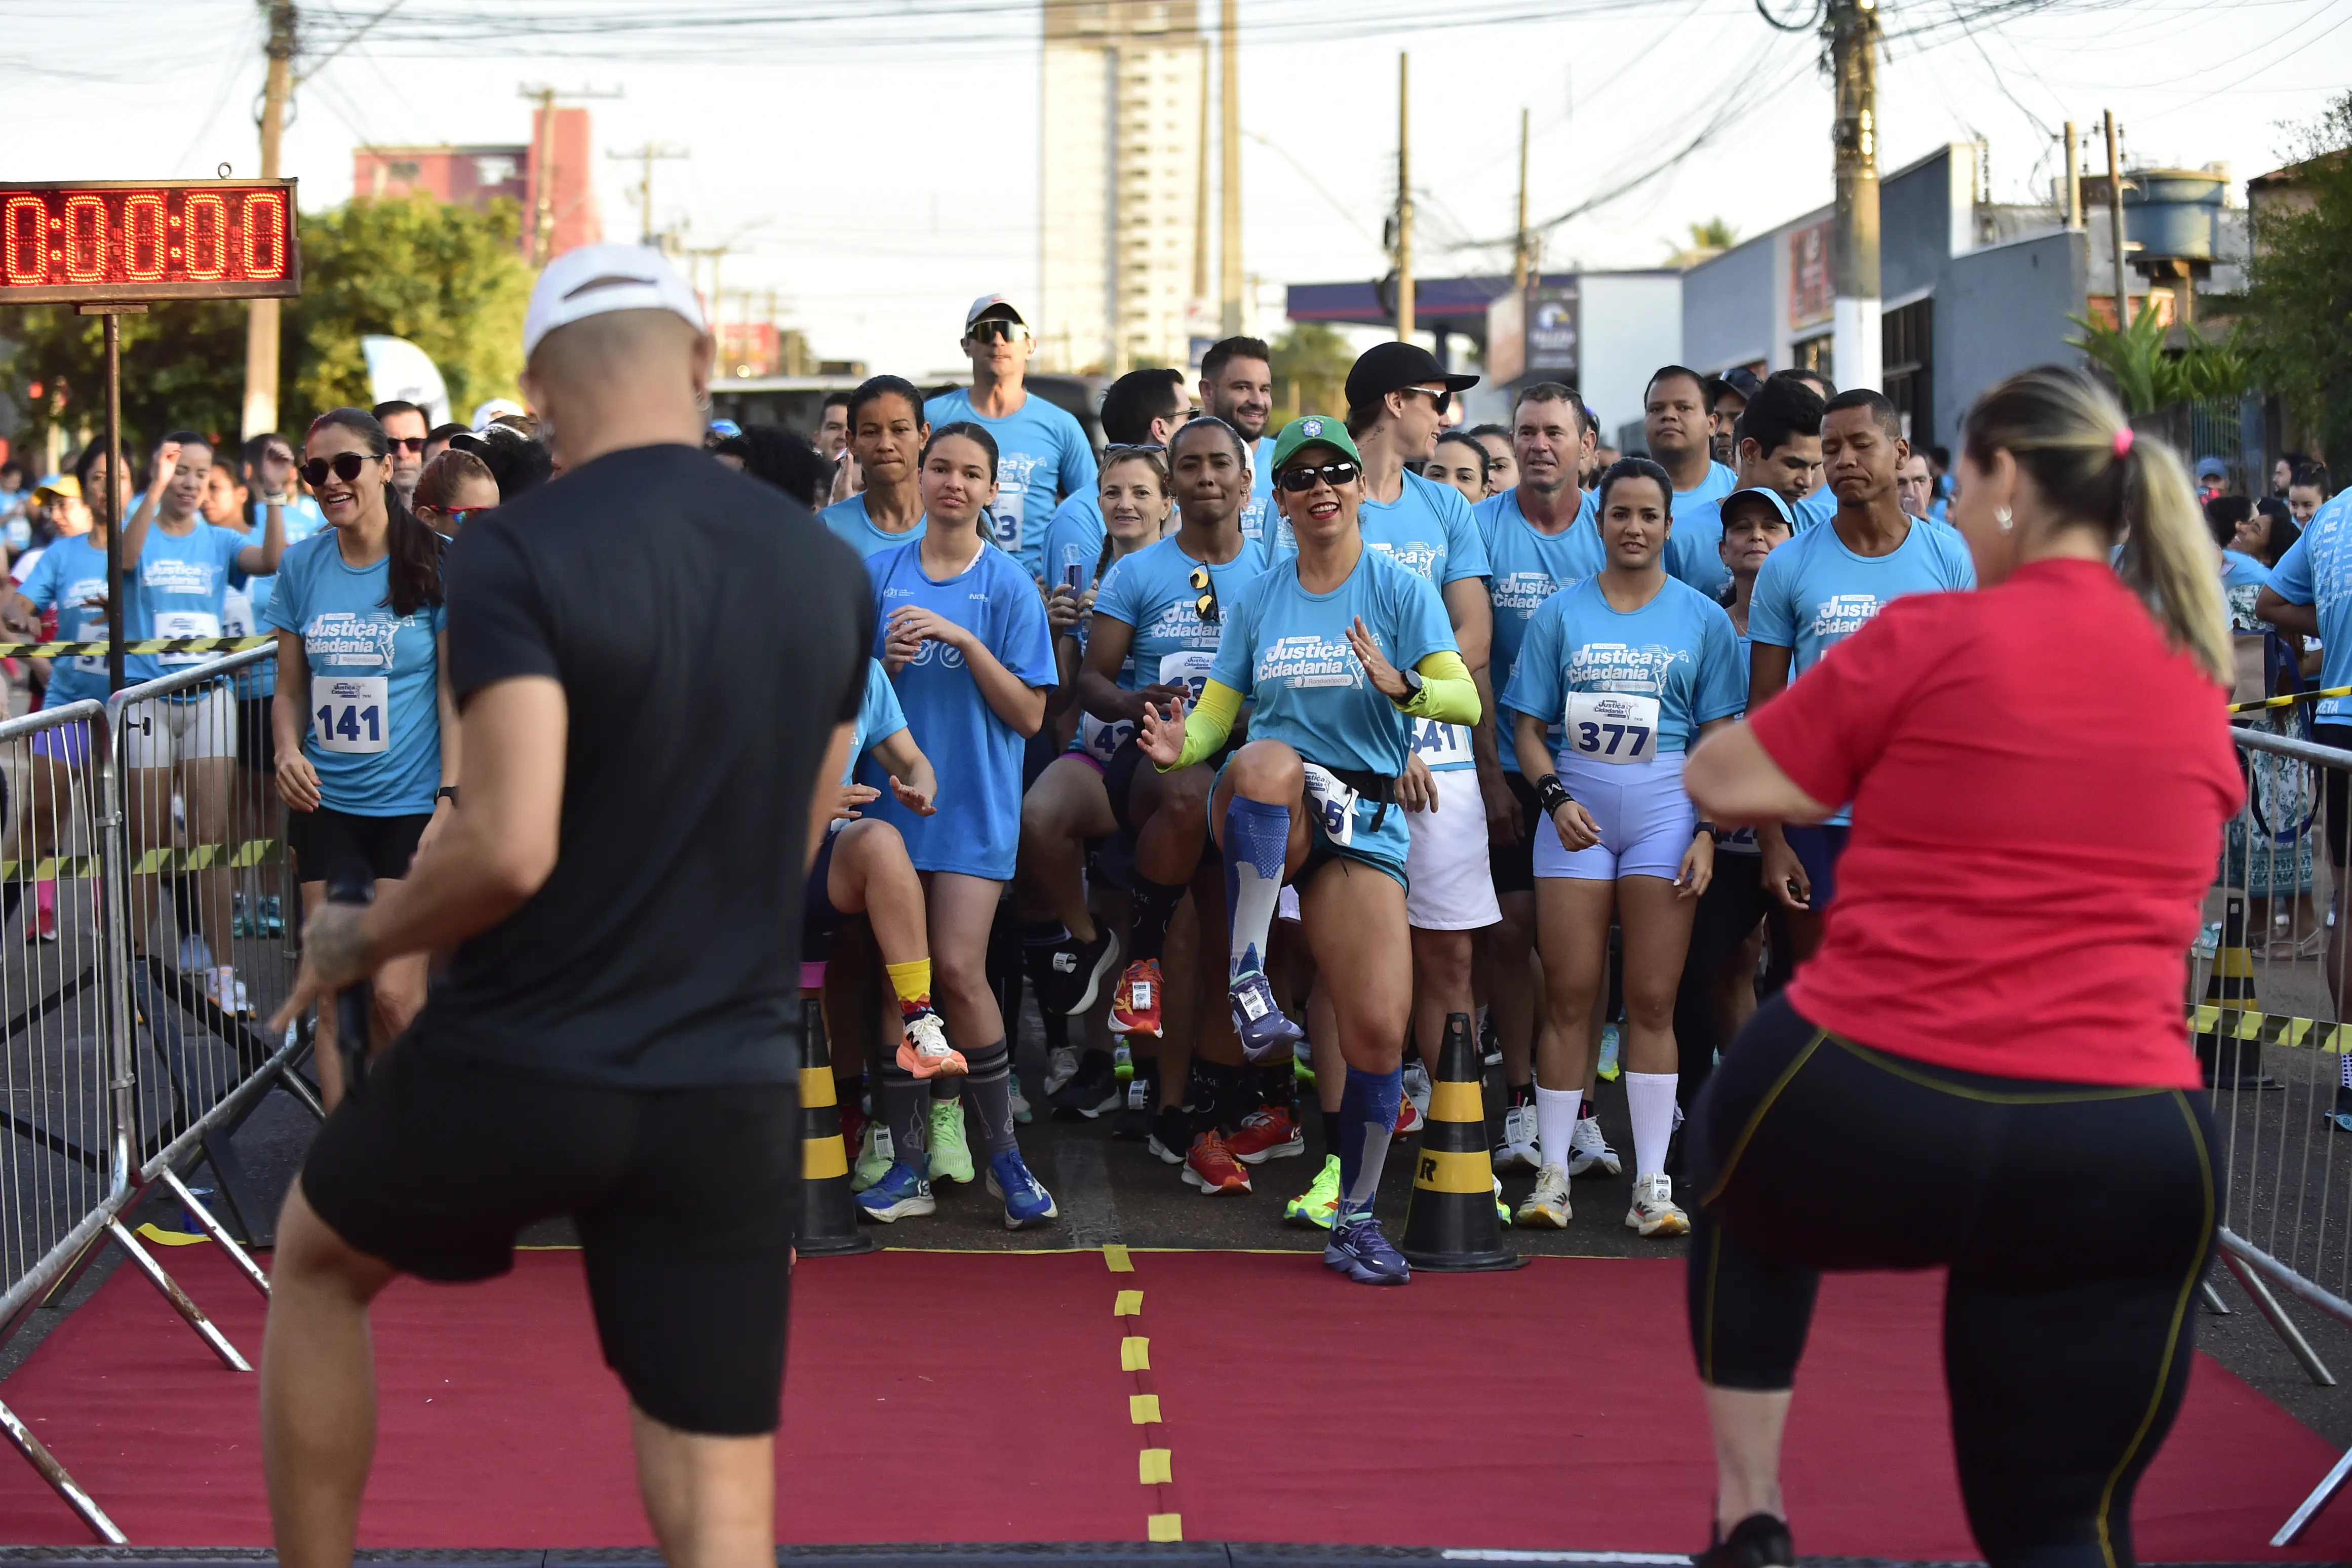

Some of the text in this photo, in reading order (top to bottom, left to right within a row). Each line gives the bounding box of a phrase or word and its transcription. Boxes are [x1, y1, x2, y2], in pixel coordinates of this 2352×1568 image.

[308, 614, 378, 640] Justiça
[306, 638, 374, 654] Cidadania
[1266, 639, 1347, 662] Justiça
[1573, 644, 1653, 667] Justiça
[1260, 659, 1343, 680] Cidadania
[1567, 664, 1649, 684] Cidadania
[1598, 700, 1625, 709] Justiça
[317, 704, 380, 741] 141
[1578, 721, 1650, 756] 377
[1420, 1157, 1437, 1182] R
